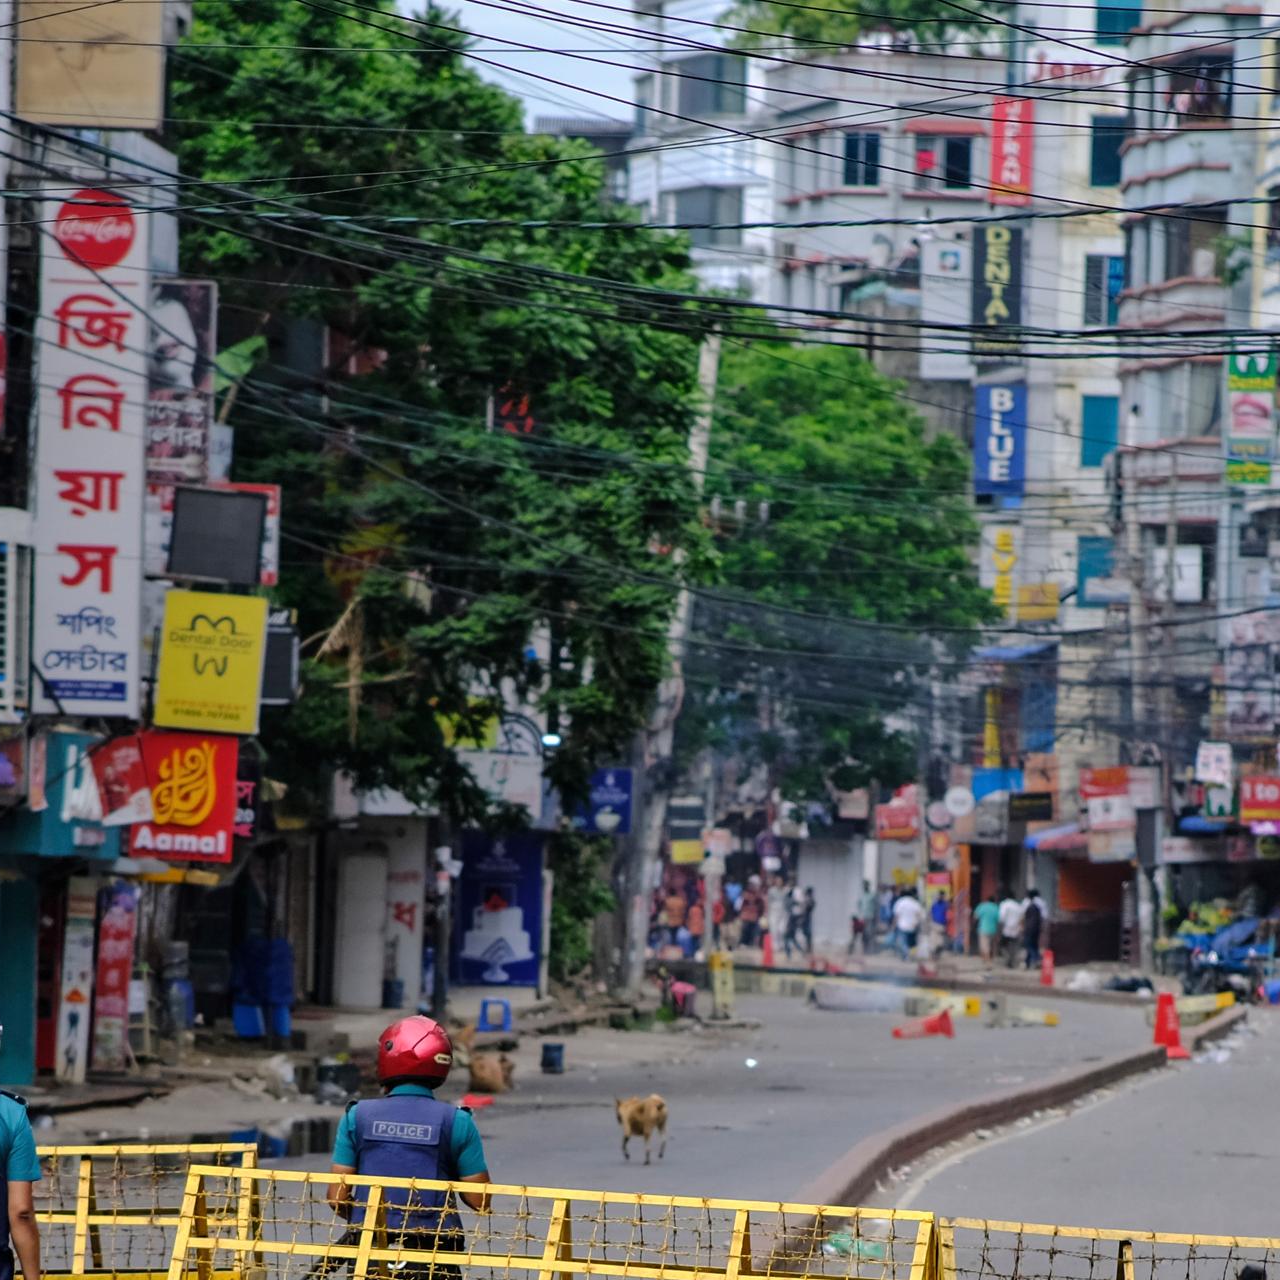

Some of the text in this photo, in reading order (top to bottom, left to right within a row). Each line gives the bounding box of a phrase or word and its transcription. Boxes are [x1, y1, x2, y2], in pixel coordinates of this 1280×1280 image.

[987, 387, 1015, 483] BLUE
[56, 606, 118, 639] শপিং
[168, 630, 253, 649] Dental Door
[43, 644, 129, 672] সেন্টার
[133, 825, 228, 855] Aamal
[378, 1123, 425, 1138] POLICE
